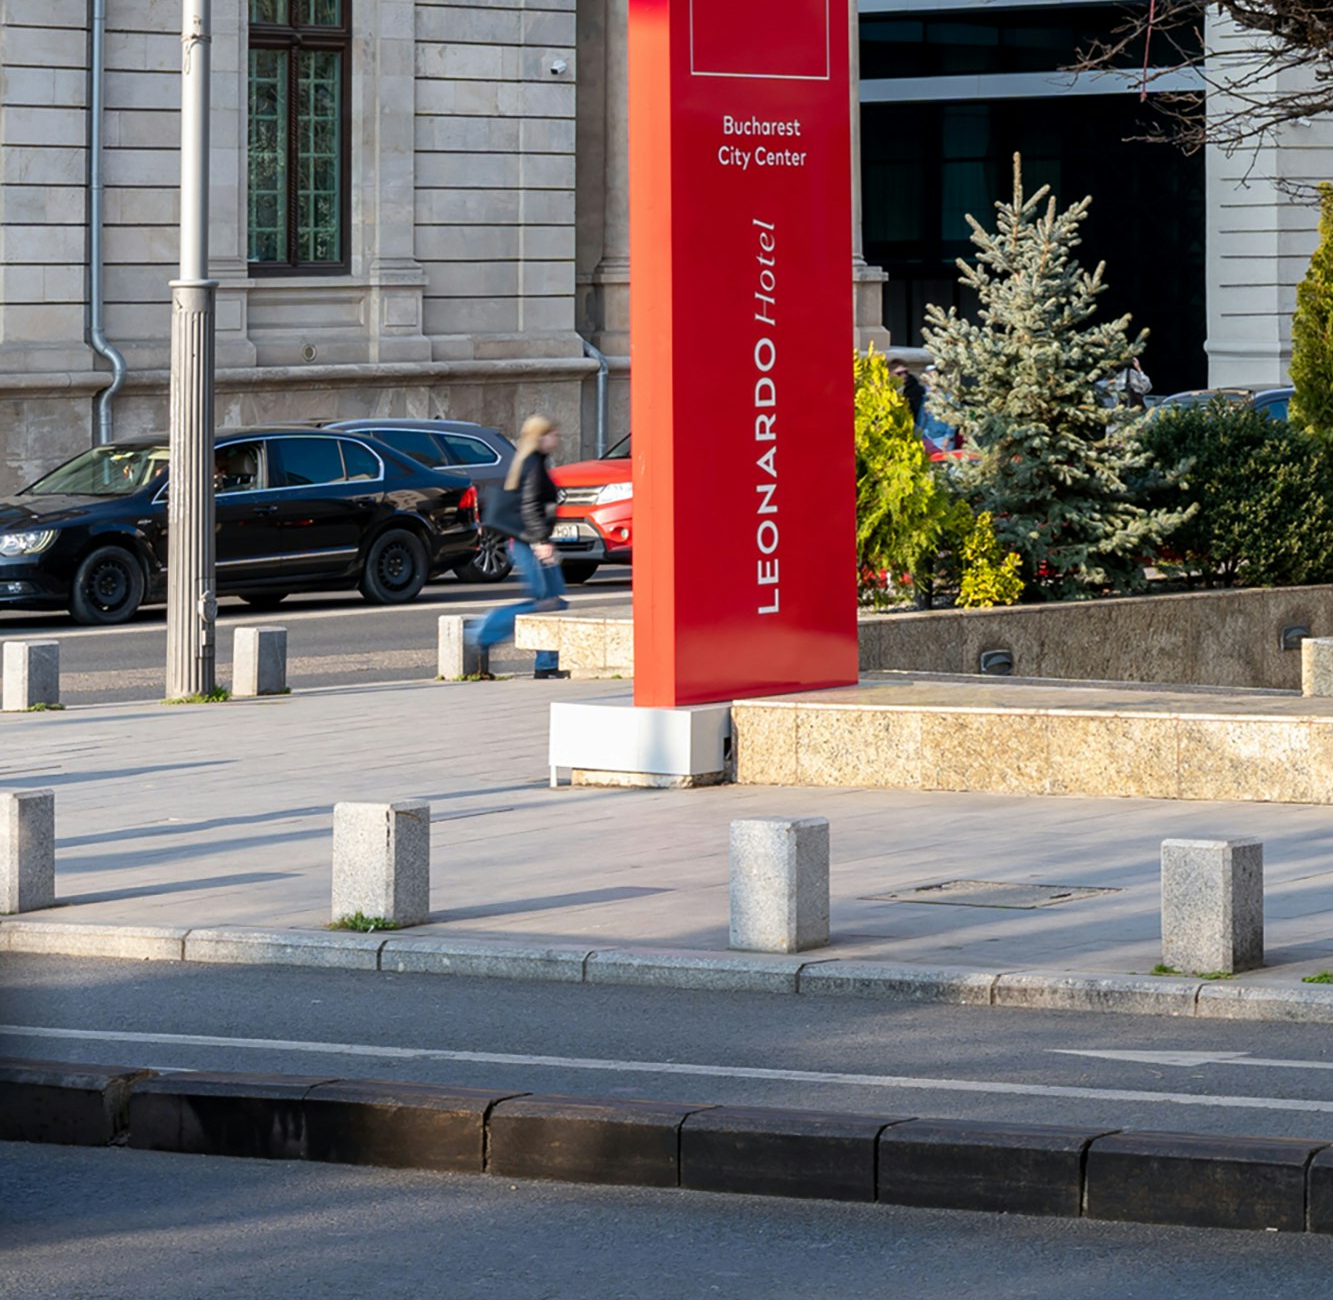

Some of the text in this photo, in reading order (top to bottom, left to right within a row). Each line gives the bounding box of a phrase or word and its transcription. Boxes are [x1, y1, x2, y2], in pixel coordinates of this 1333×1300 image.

[723, 115, 801, 137] Bucharest
[718, 145, 807, 170] City Center
[752, 218, 780, 615] LEONARDO Hotel
